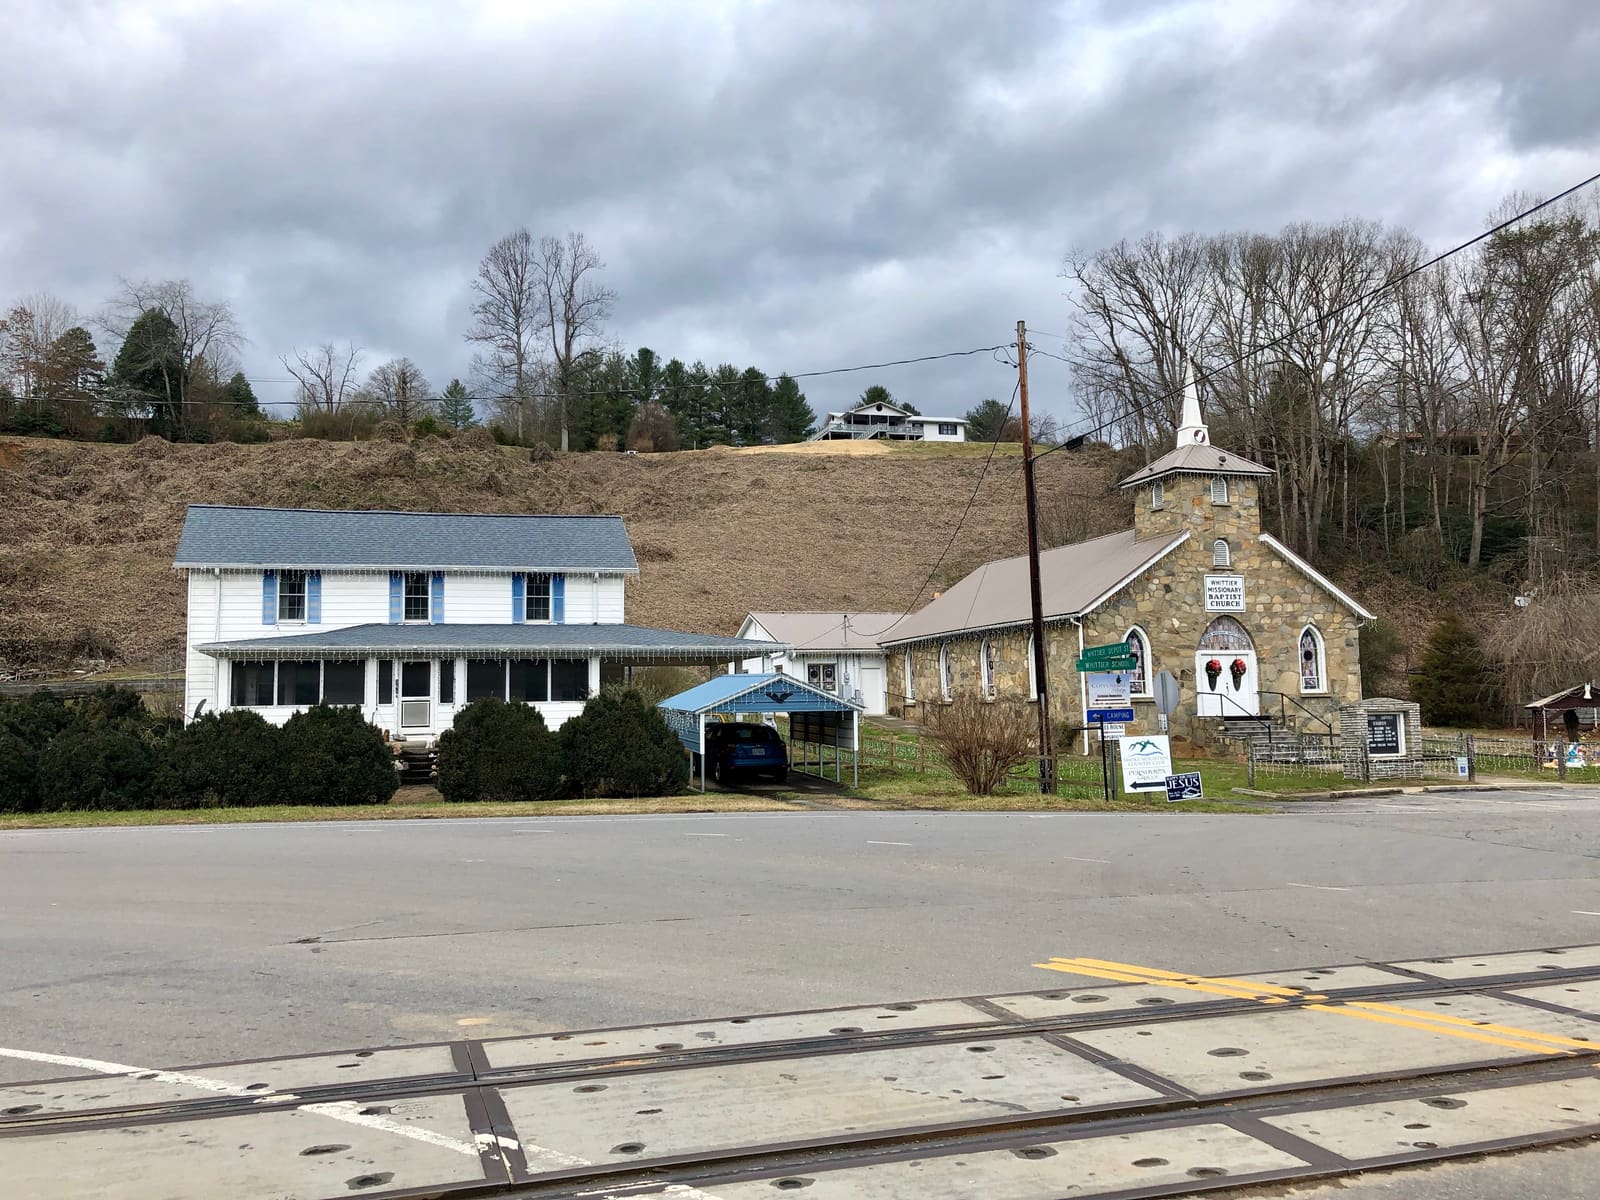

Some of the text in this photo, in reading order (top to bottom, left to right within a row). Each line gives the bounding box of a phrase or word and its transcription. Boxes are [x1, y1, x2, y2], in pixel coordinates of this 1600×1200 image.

[1085, 660, 1130, 669] WHITTIER SCHOOL
[1106, 711, 1130, 719] CAMPING
[1167, 777, 1199, 790] JESUS
